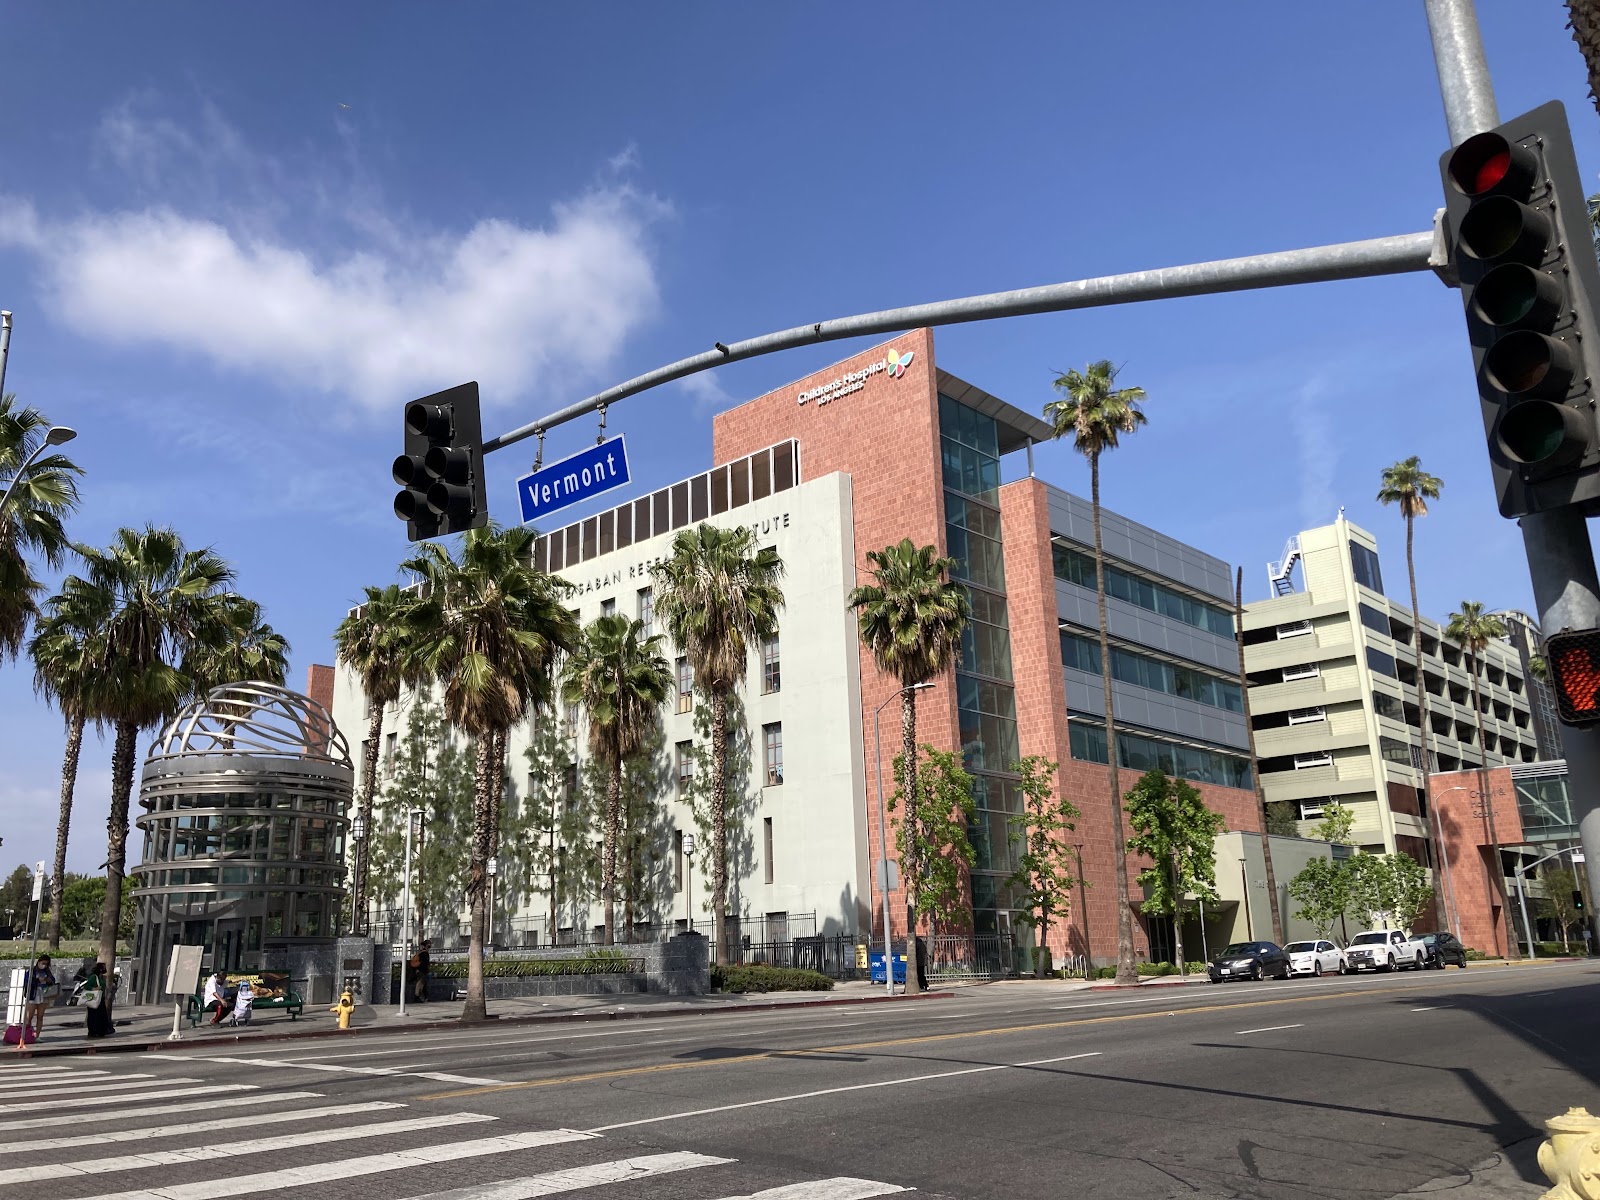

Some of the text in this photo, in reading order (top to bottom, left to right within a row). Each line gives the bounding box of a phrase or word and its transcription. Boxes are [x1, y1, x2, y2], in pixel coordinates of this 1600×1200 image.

[797, 358, 887, 405] Children's Hospital
[817, 380, 866, 406] LOS ANGELES
[528, 452, 617, 508] Vermont
[578, 569, 621, 597] SABAN
[1472, 810, 1500, 819] Sabn
